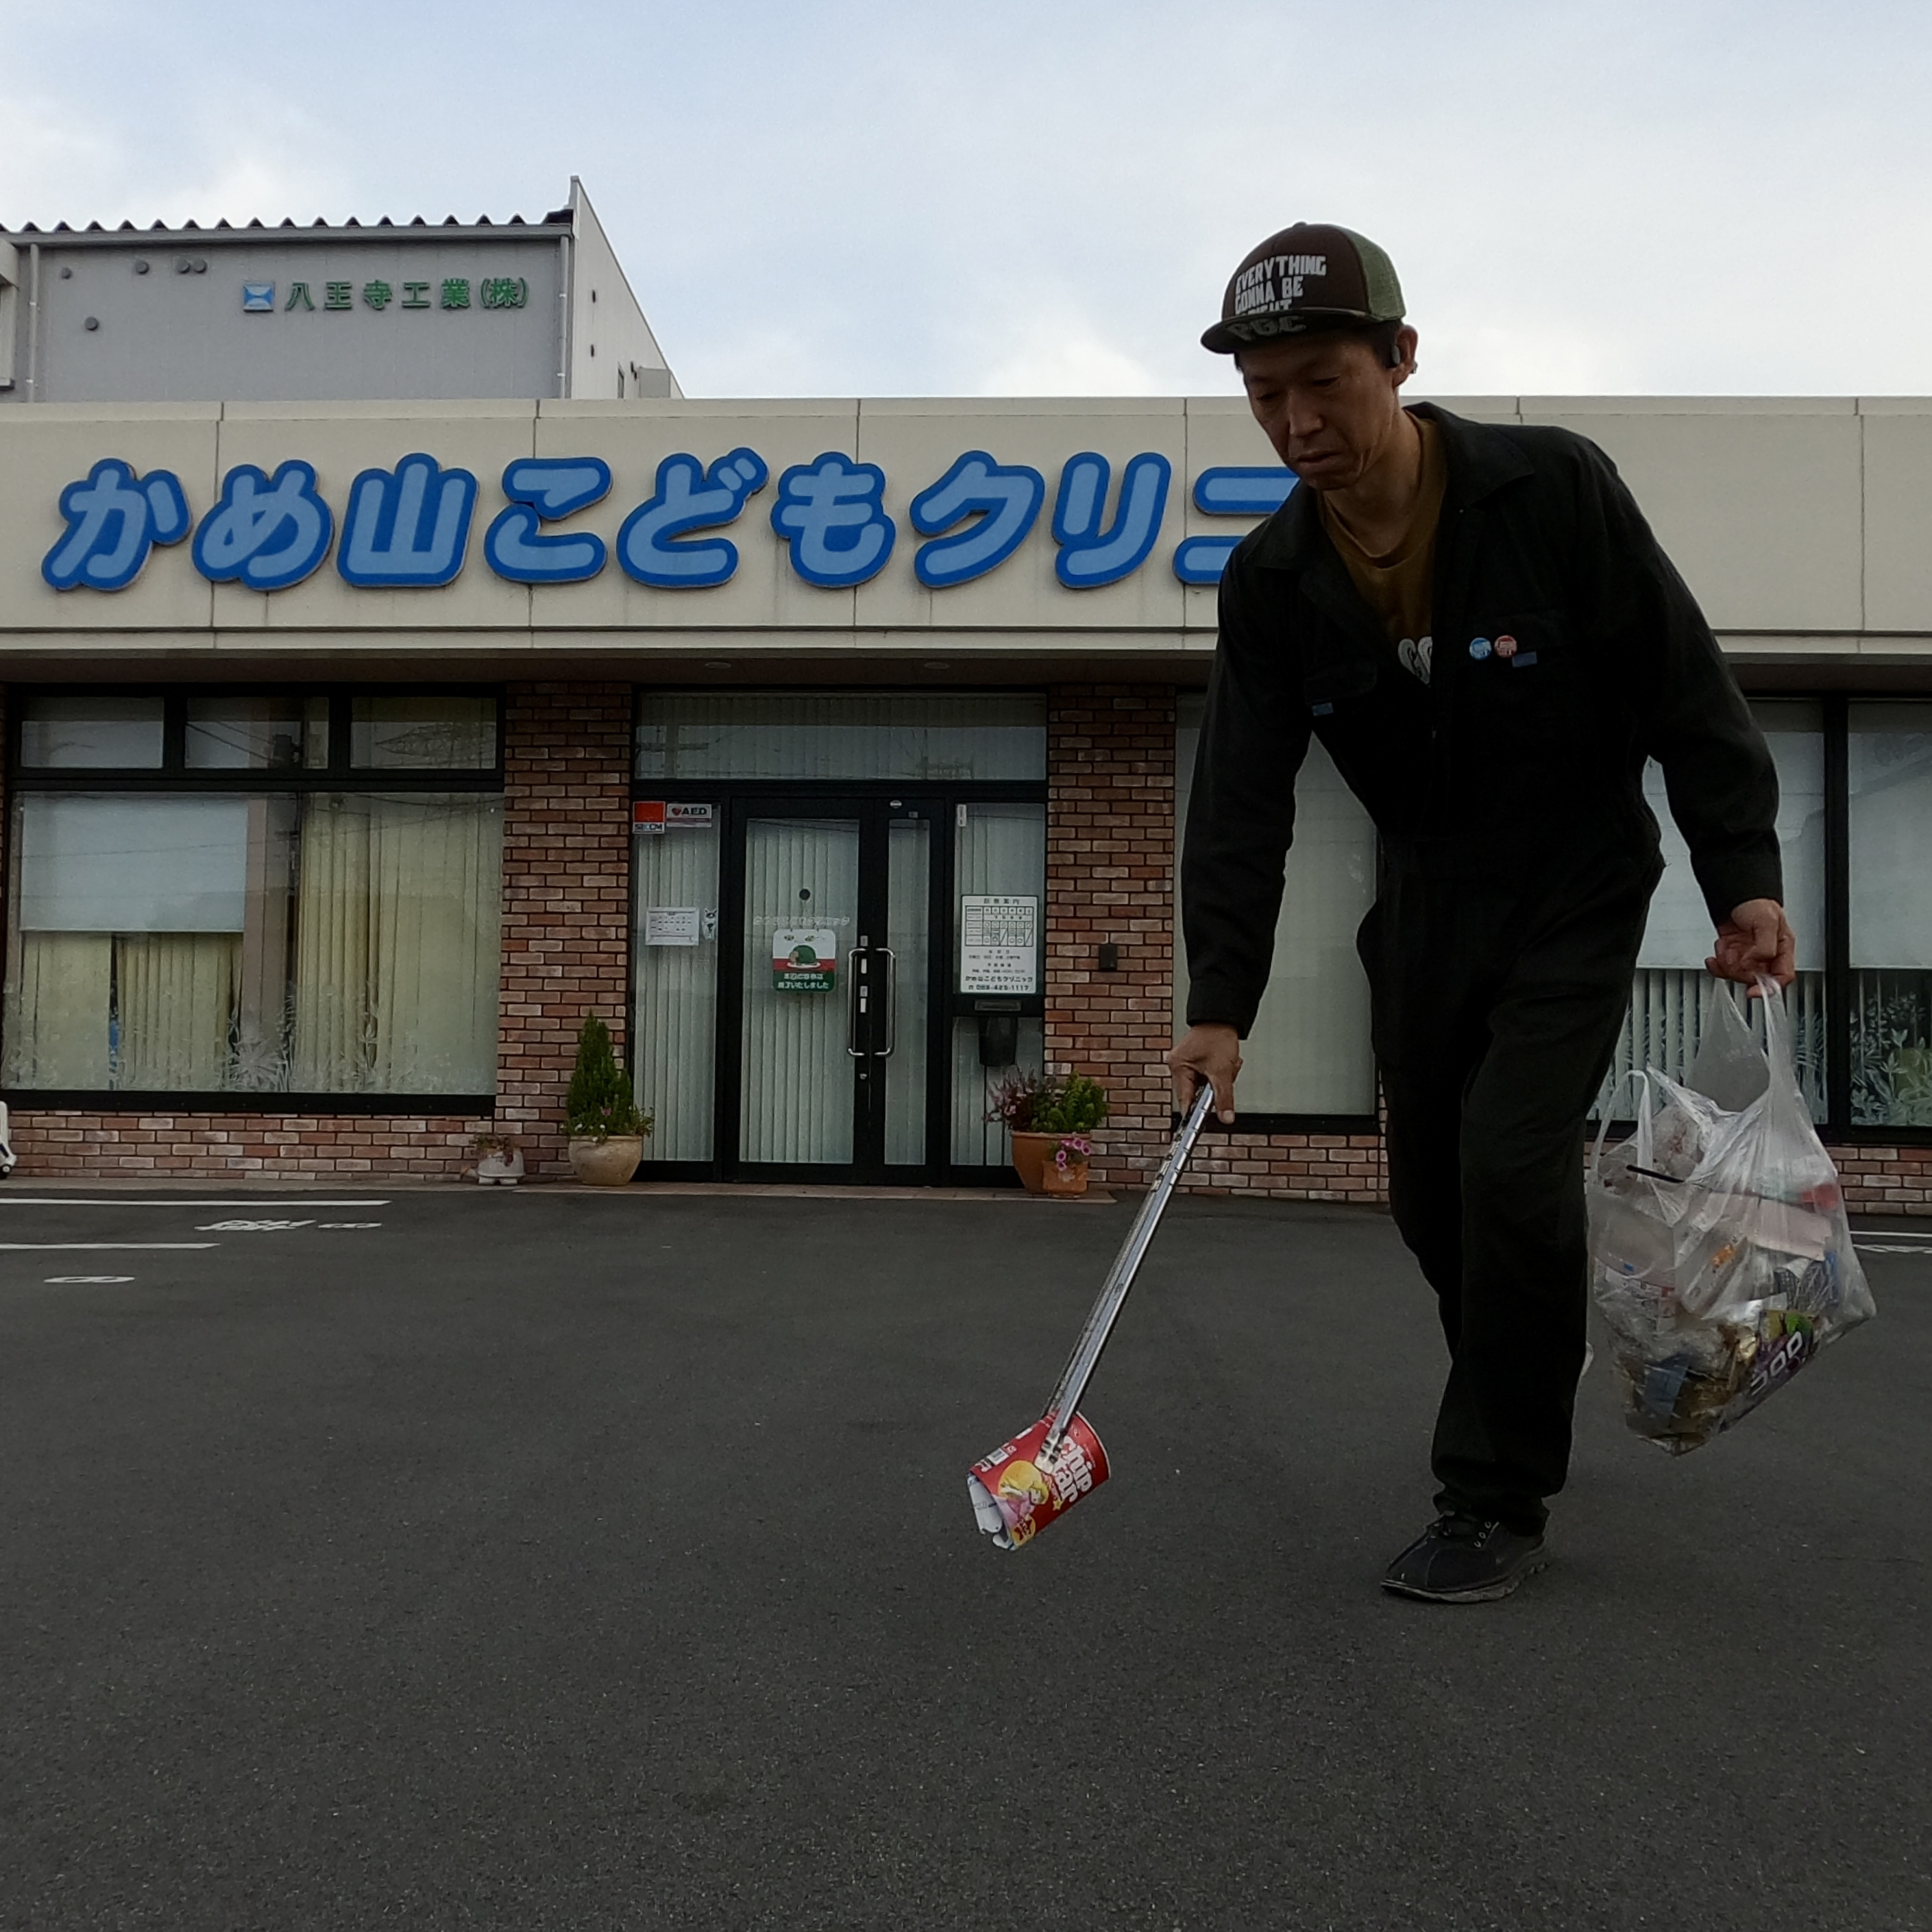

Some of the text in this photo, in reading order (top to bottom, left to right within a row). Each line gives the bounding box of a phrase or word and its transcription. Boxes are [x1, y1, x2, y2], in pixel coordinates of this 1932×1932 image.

[1235, 254, 1327, 295] EVERYTHING
[1235, 281, 1275, 315] GONNA
[1282, 276, 1304, 299] BE
[682, 807, 707, 816] AED
[1053, 1453, 1079, 1503] tar
